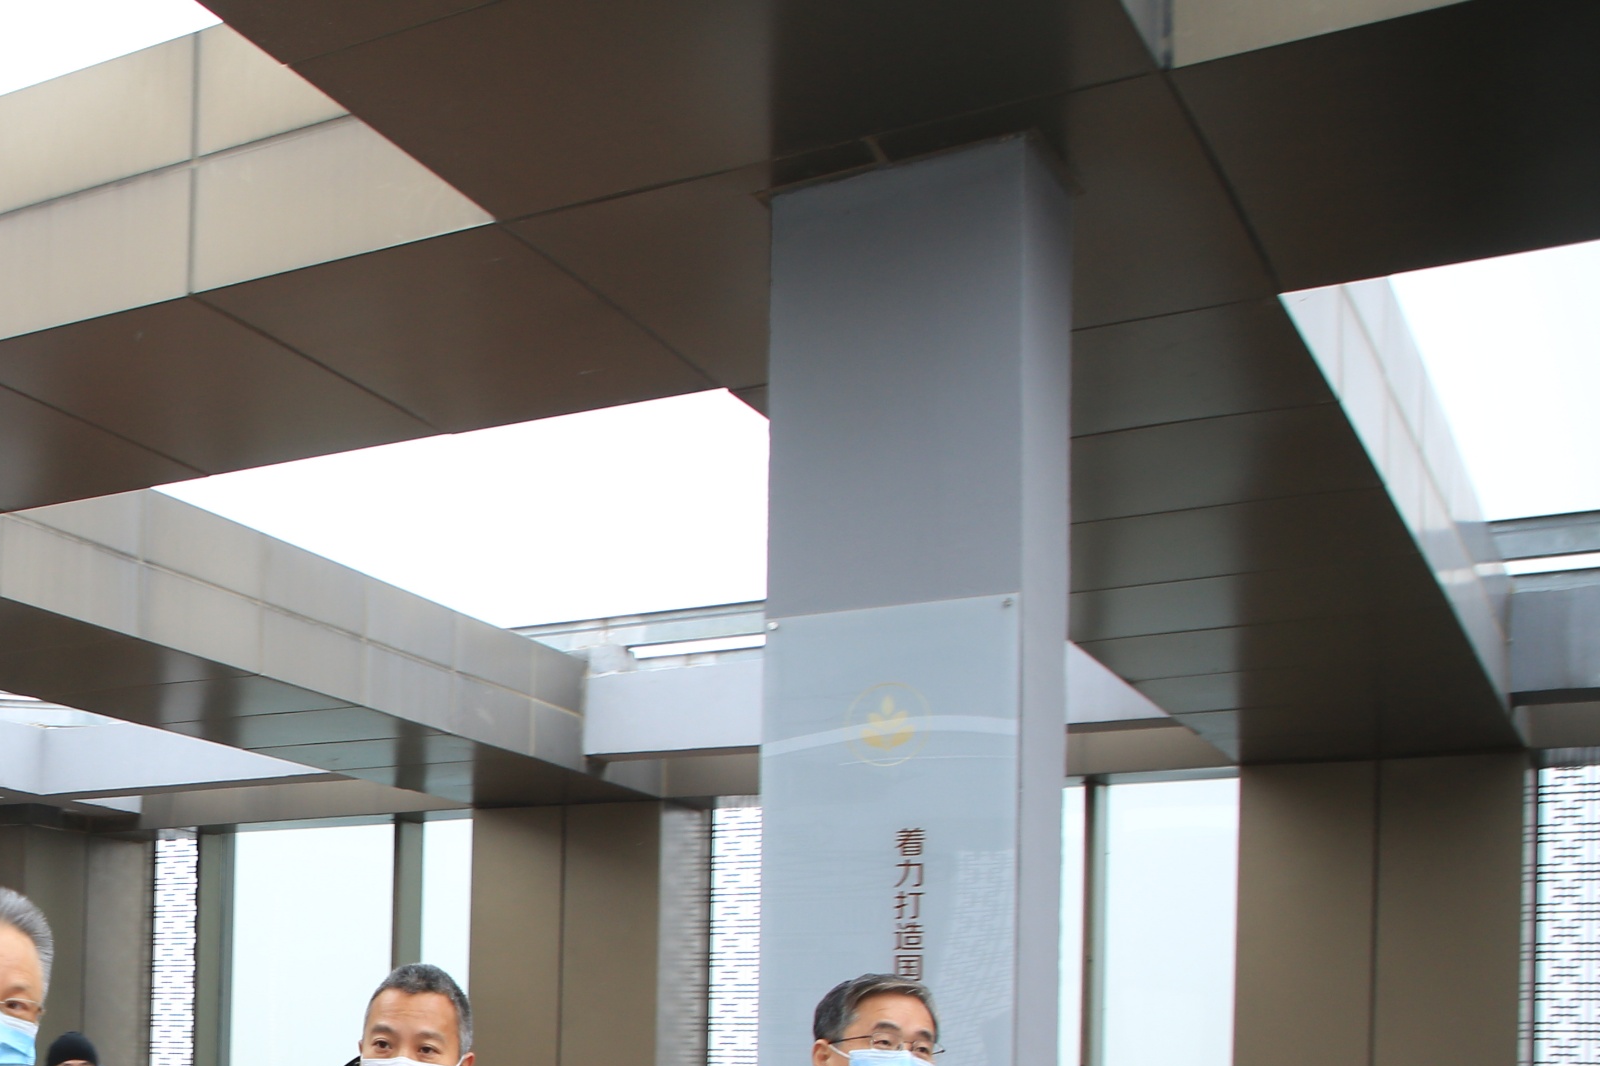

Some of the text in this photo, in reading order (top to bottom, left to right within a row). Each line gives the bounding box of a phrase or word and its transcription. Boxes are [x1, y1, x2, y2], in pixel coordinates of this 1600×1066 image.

[893, 827, 926, 981] 着力打造国
